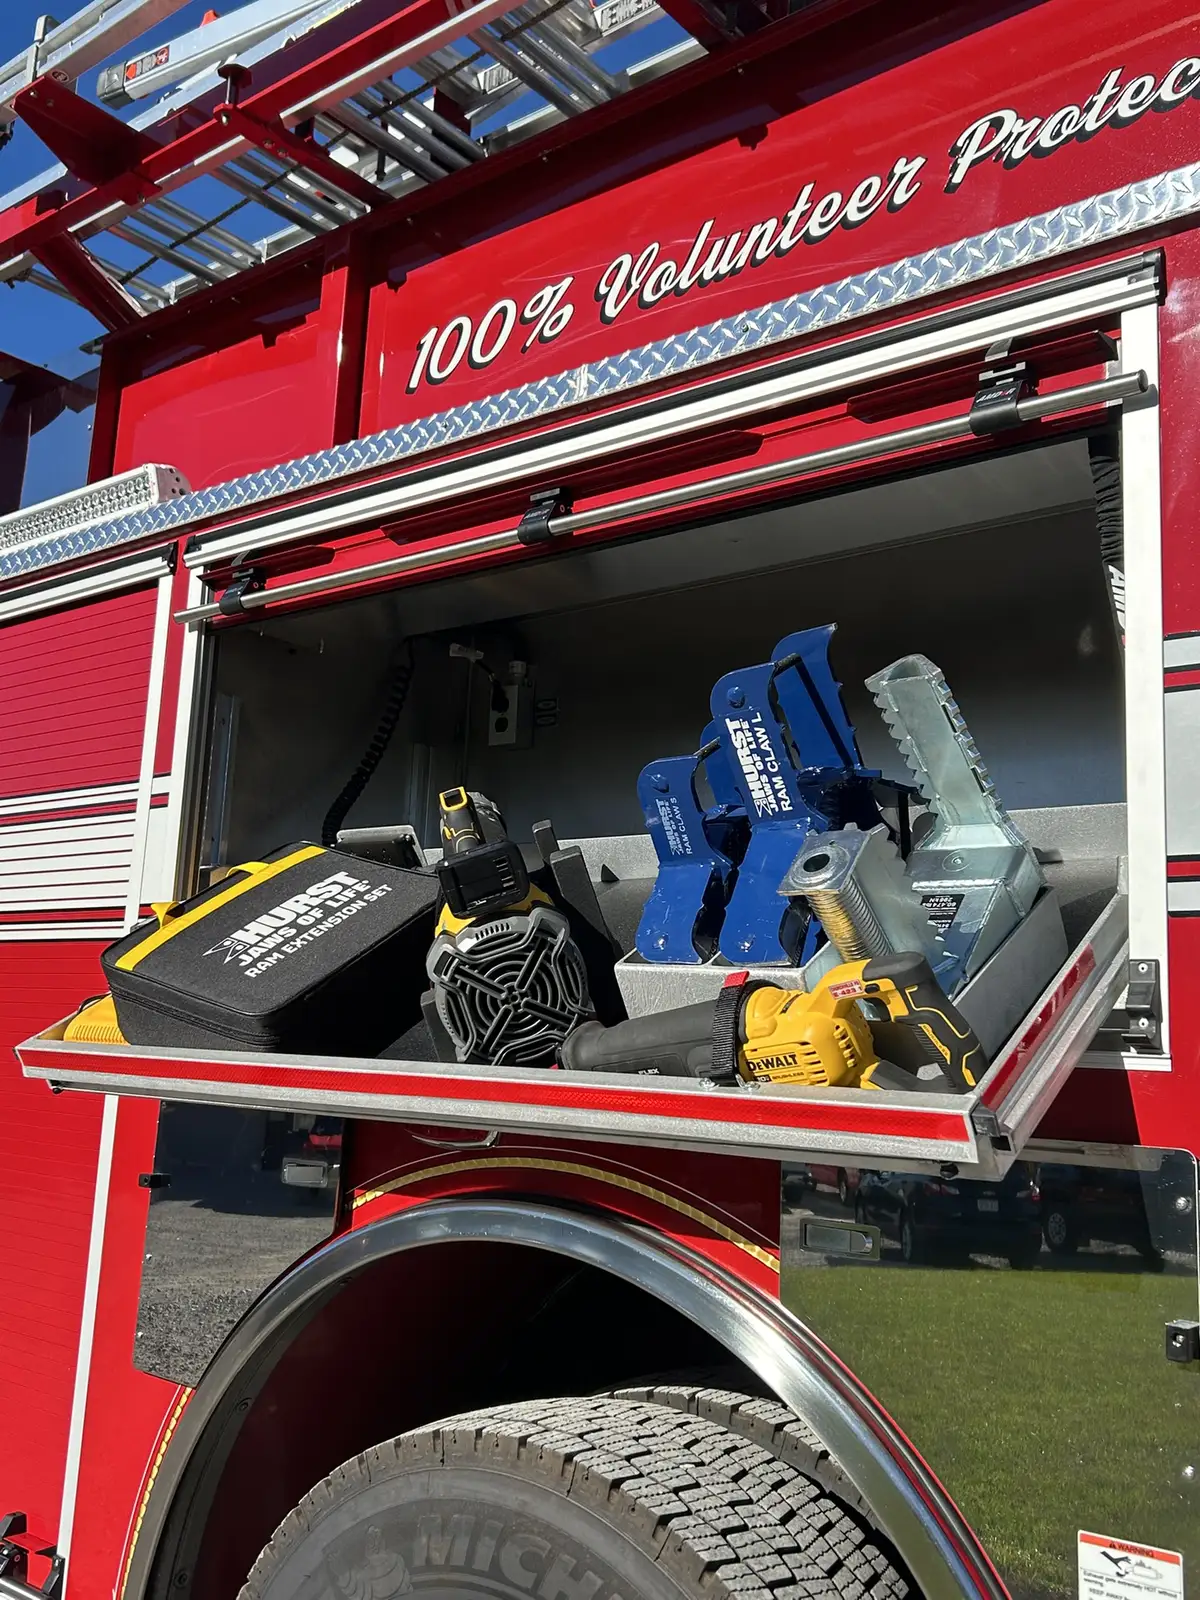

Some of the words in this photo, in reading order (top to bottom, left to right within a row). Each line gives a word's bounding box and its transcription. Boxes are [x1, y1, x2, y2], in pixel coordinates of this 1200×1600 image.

[406, 276, 575, 394] 100%
[596, 155, 927, 324] Volunteer
[944, 56, 1200, 193] Protec
[740, 720, 757, 750] LIFE
[751, 712, 762, 723] L
[725, 717, 767, 800] HURST
[752, 753, 764, 771] OF
[754, 727, 779, 773] CLAW
[759, 774, 779, 813] JAWS
[771, 775, 794, 812] RAM
[655, 798, 677, 846] HURST
[670, 820, 677, 830] OF
[672, 805, 686, 832] CLAW
[673, 832, 685, 854] JAWS
[681, 834, 693, 855] RAM
[230, 871, 360, 946] HURST
[237, 926, 298, 967] JAWS
[296, 907, 324, 926] OF
[326, 881, 371, 908] LIFE
[244, 952, 285, 978] RAM
[281, 899, 368, 954] EXTENSION
[363, 883, 393, 902] SET
[1118, 1544, 1154, 1558] WARNING
